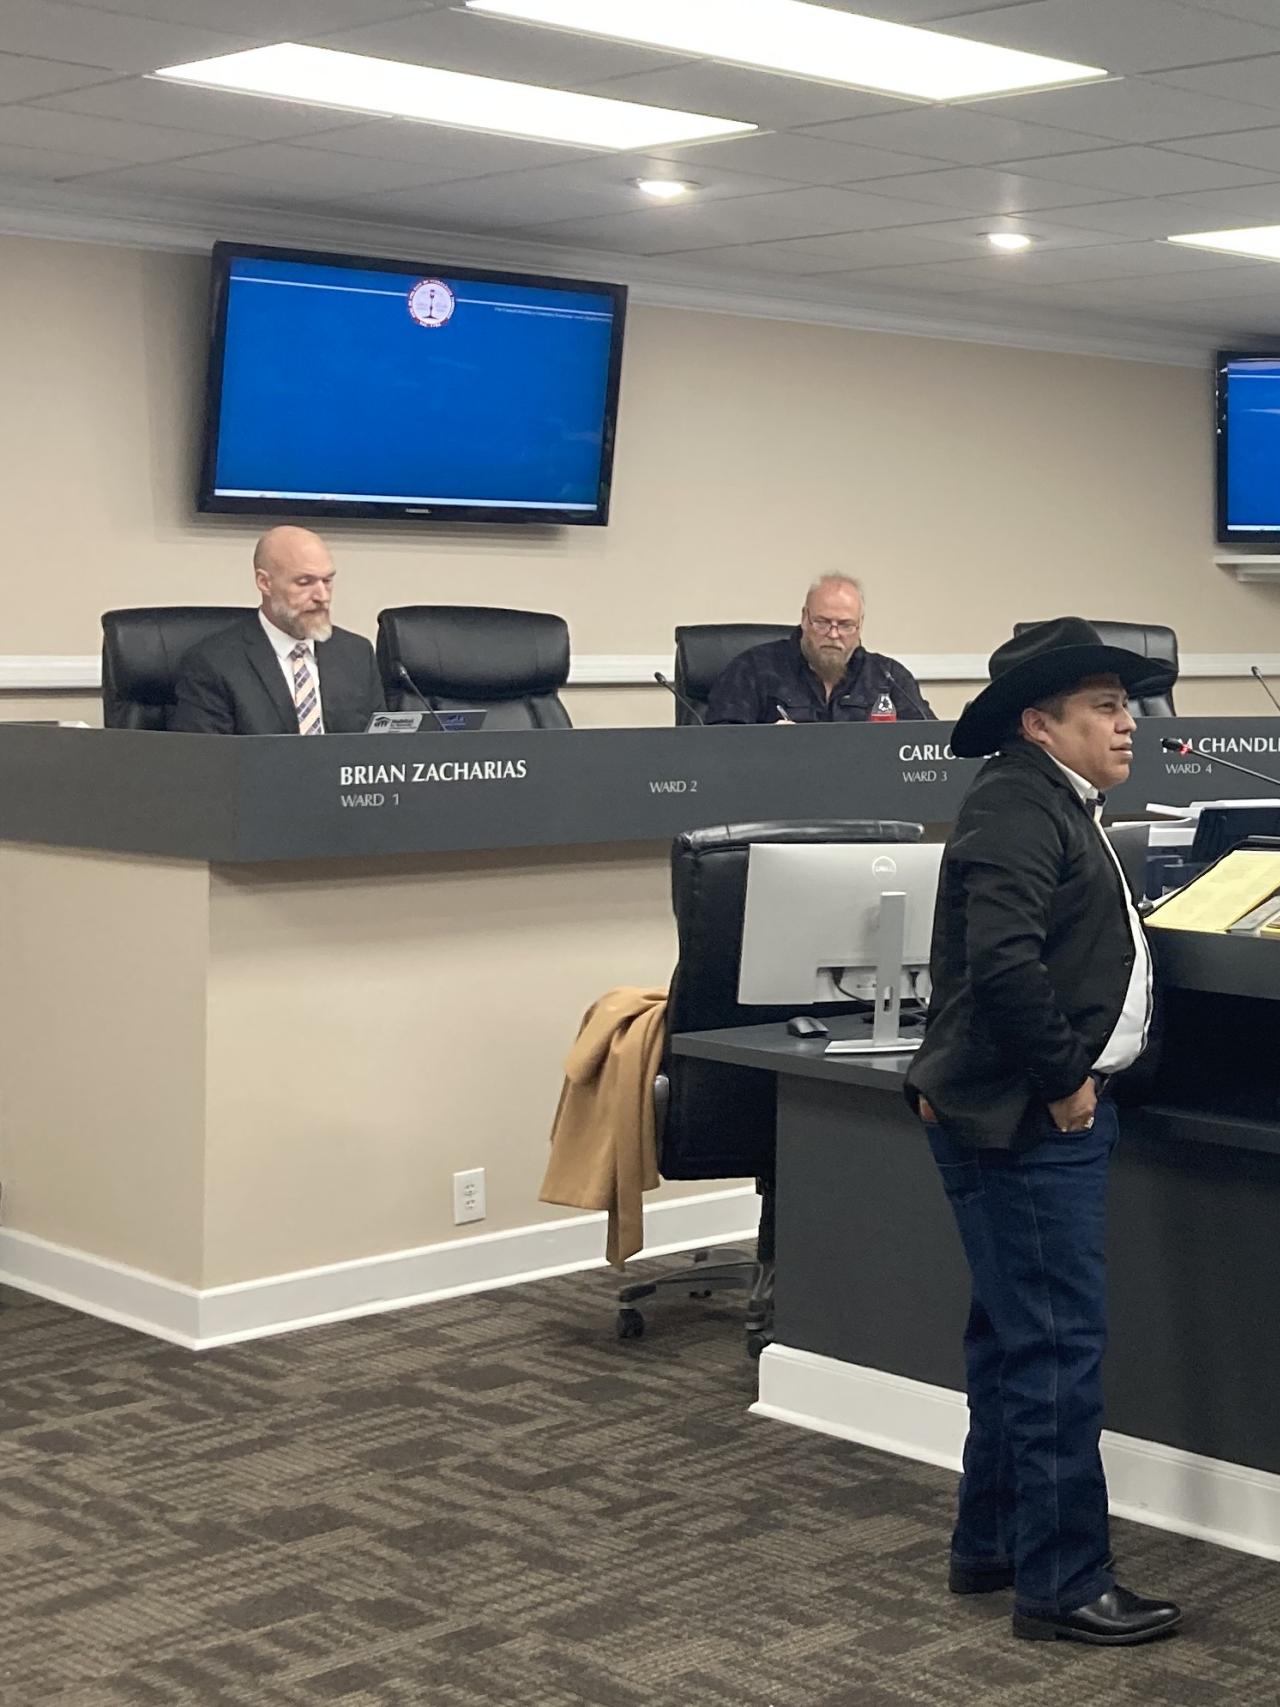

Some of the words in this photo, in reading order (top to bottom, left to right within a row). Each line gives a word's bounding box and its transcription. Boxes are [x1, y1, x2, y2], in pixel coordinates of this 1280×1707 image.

[898, 744, 965, 761] CARLO
[340, 763, 406, 786] BRIAN
[411, 759, 527, 783] ZACHARIAS
[1165, 763, 1201, 774] WARD
[1205, 763, 1212, 774] 4
[902, 770, 937, 783] WARD
[940, 770, 948, 782] 3
[649, 780, 687, 793] WARD
[690, 780, 697, 792] 2
[340, 793, 385, 808] WARD
[391, 793, 400, 807] 1
